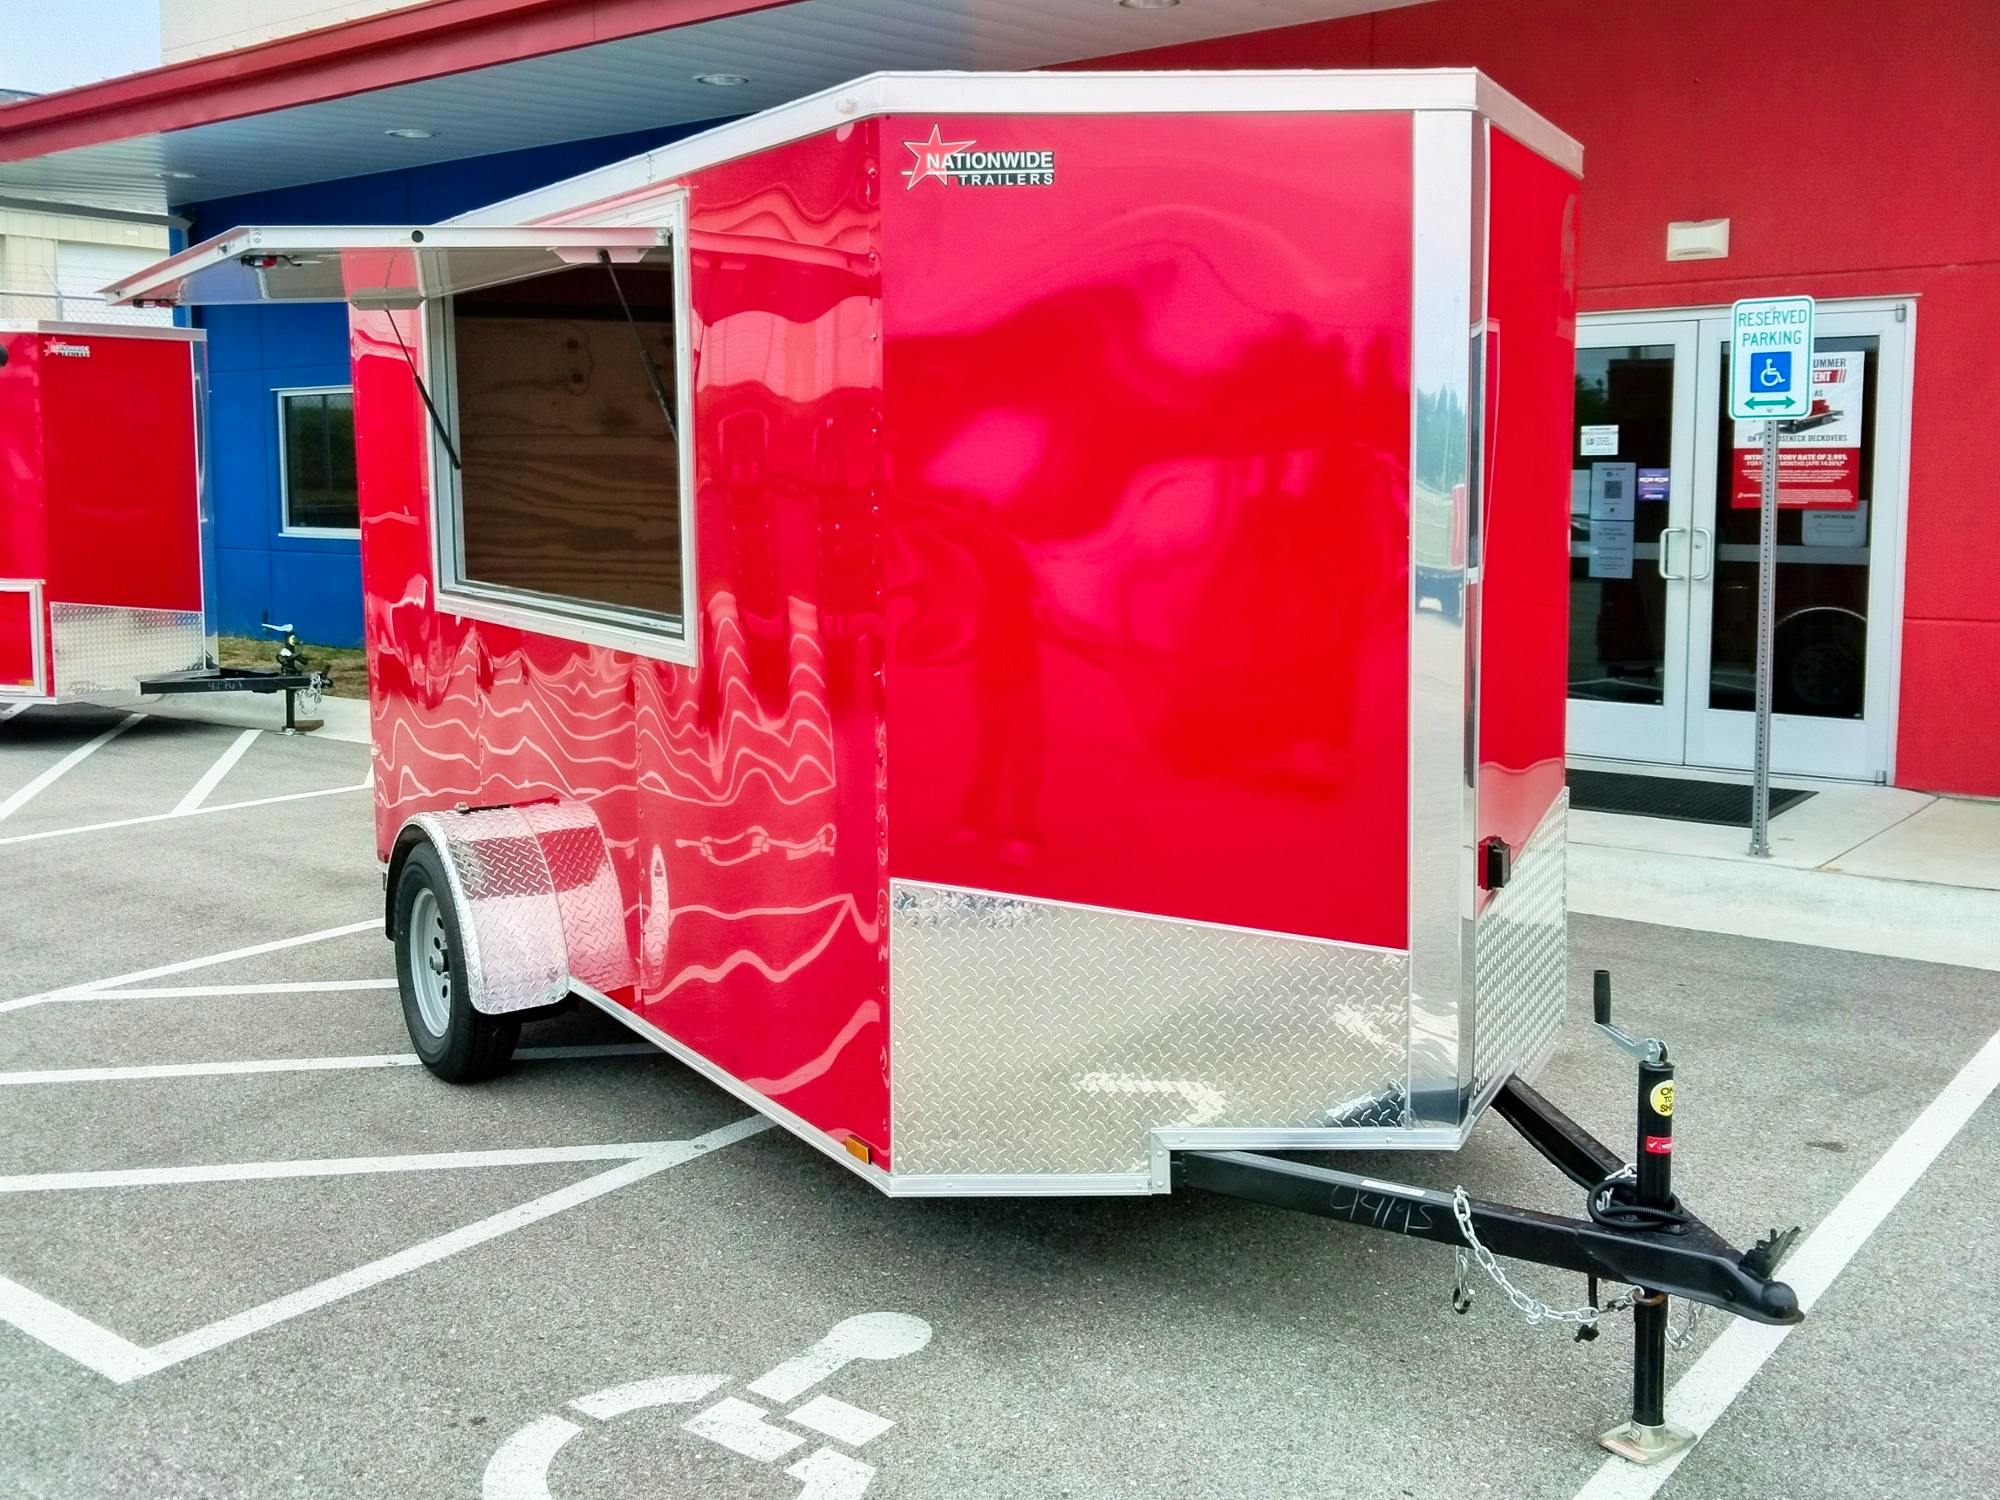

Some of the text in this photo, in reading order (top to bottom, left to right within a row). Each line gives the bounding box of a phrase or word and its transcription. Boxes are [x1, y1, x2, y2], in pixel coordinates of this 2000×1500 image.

[926, 151, 1054, 169] NATIONWIDE
[959, 173, 1054, 186] TRAILERS
[1738, 309, 1808, 327] RESERVED
[1742, 330, 1802, 347] PARKING
[1813, 358, 1847, 369] UMMER
[1813, 371, 1832, 383] ENT
[1814, 389, 1824, 397] AS
